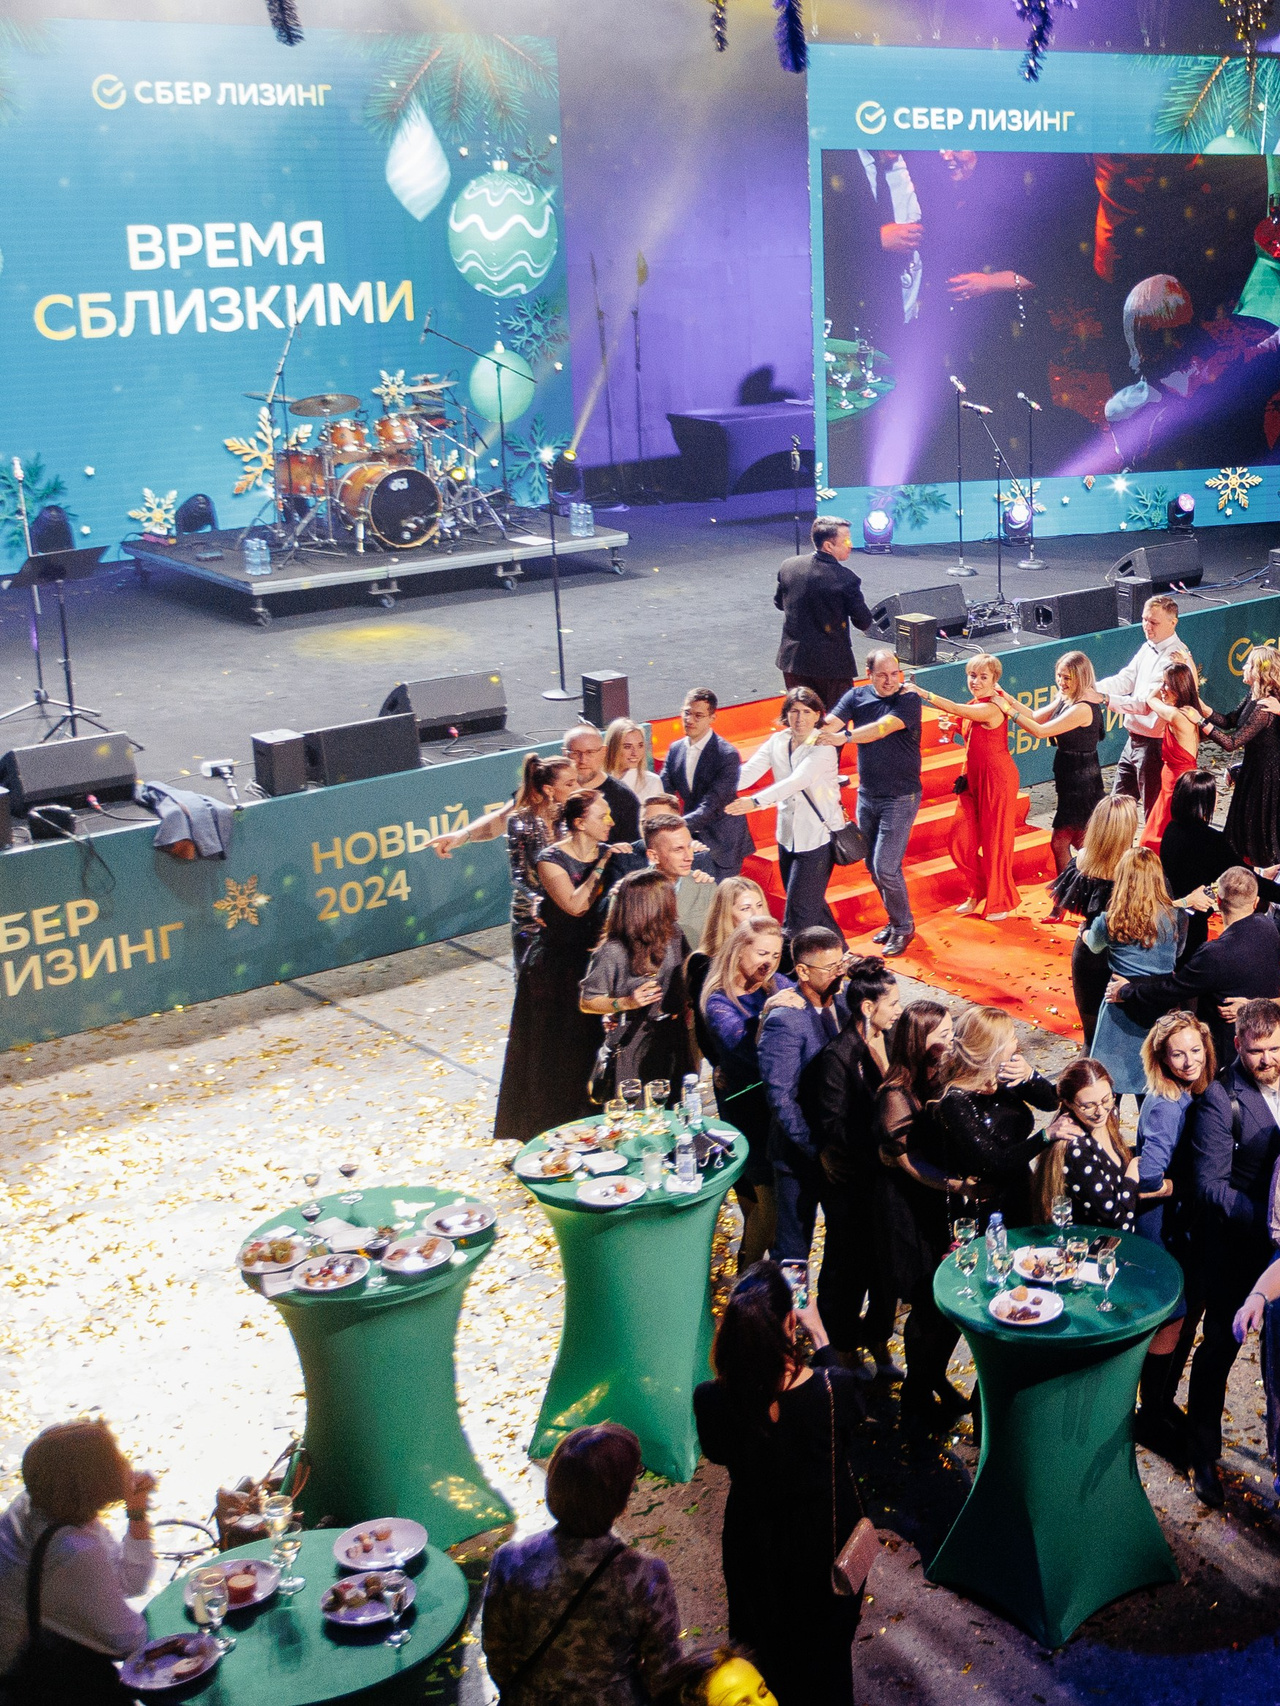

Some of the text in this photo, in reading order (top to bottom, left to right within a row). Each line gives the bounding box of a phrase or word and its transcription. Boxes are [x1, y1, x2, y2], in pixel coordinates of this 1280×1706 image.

[134, 80, 332, 107] СБЕР ЛИЗИНГ
[893, 107, 1075, 132] СБЕР ЛИЗИНГ
[126, 220, 326, 271] ВРЕМЯ
[33, 280, 416, 341] СБЛИЗКИМИ
[315, 869, 412, 922] 2024
[0, 898, 100, 953] БЕР
[3, 921, 185, 997] ИЗИНГ
